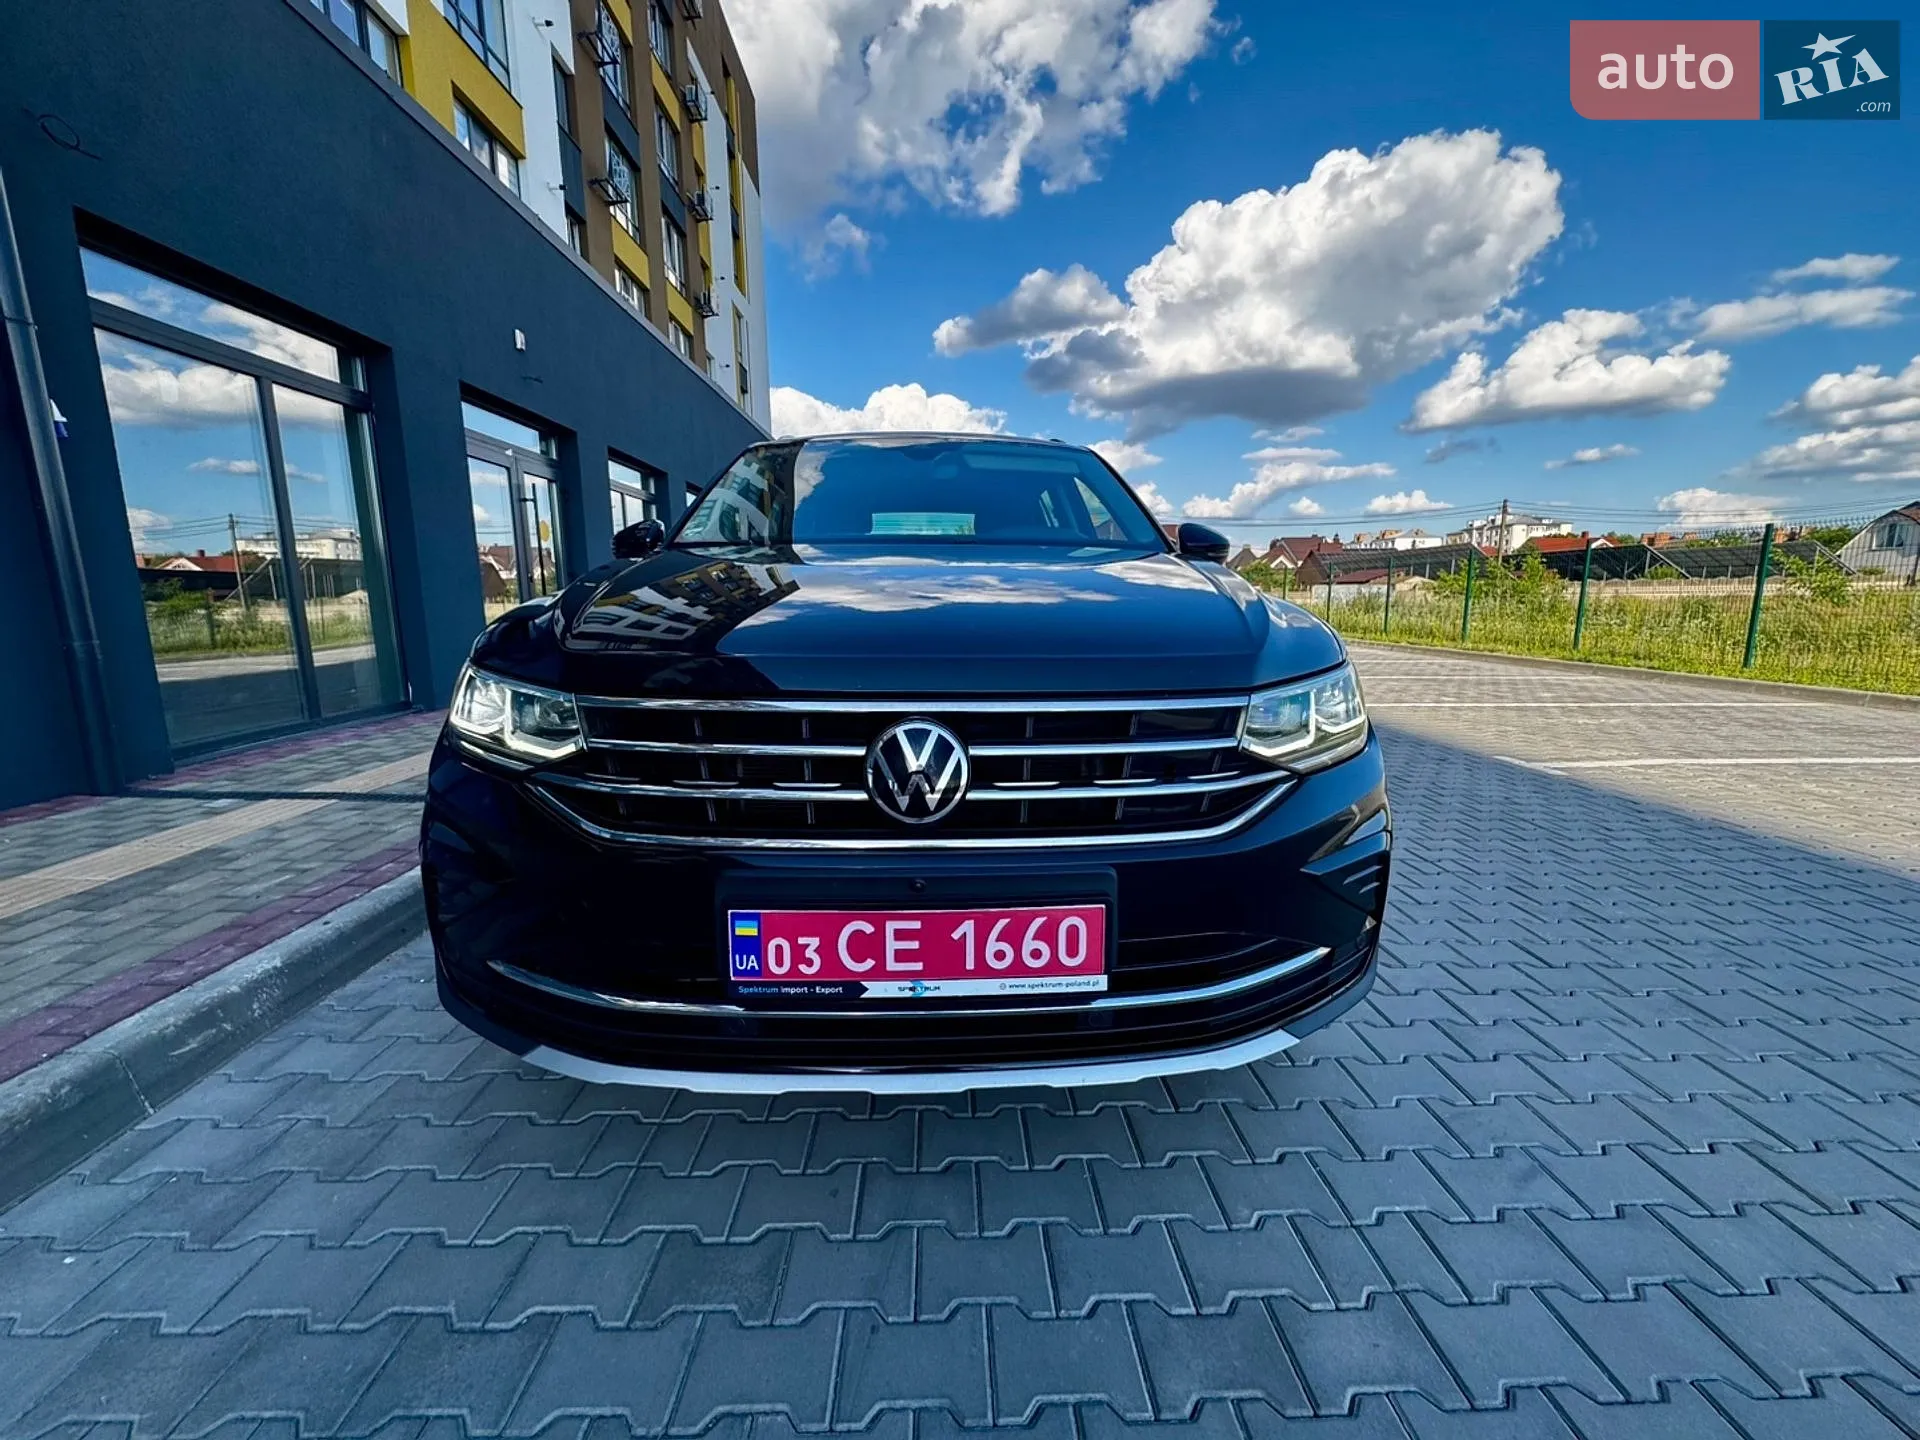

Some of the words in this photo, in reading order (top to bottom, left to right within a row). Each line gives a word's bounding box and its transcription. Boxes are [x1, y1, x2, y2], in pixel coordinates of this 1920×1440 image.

[767, 936, 822, 975] 03
[837, 919, 924, 972] CE
[950, 915, 1089, 970] 1660
[735, 954, 760, 971] UA
[738, 985, 779, 994] Spektrum
[815, 985, 843, 995] Export
